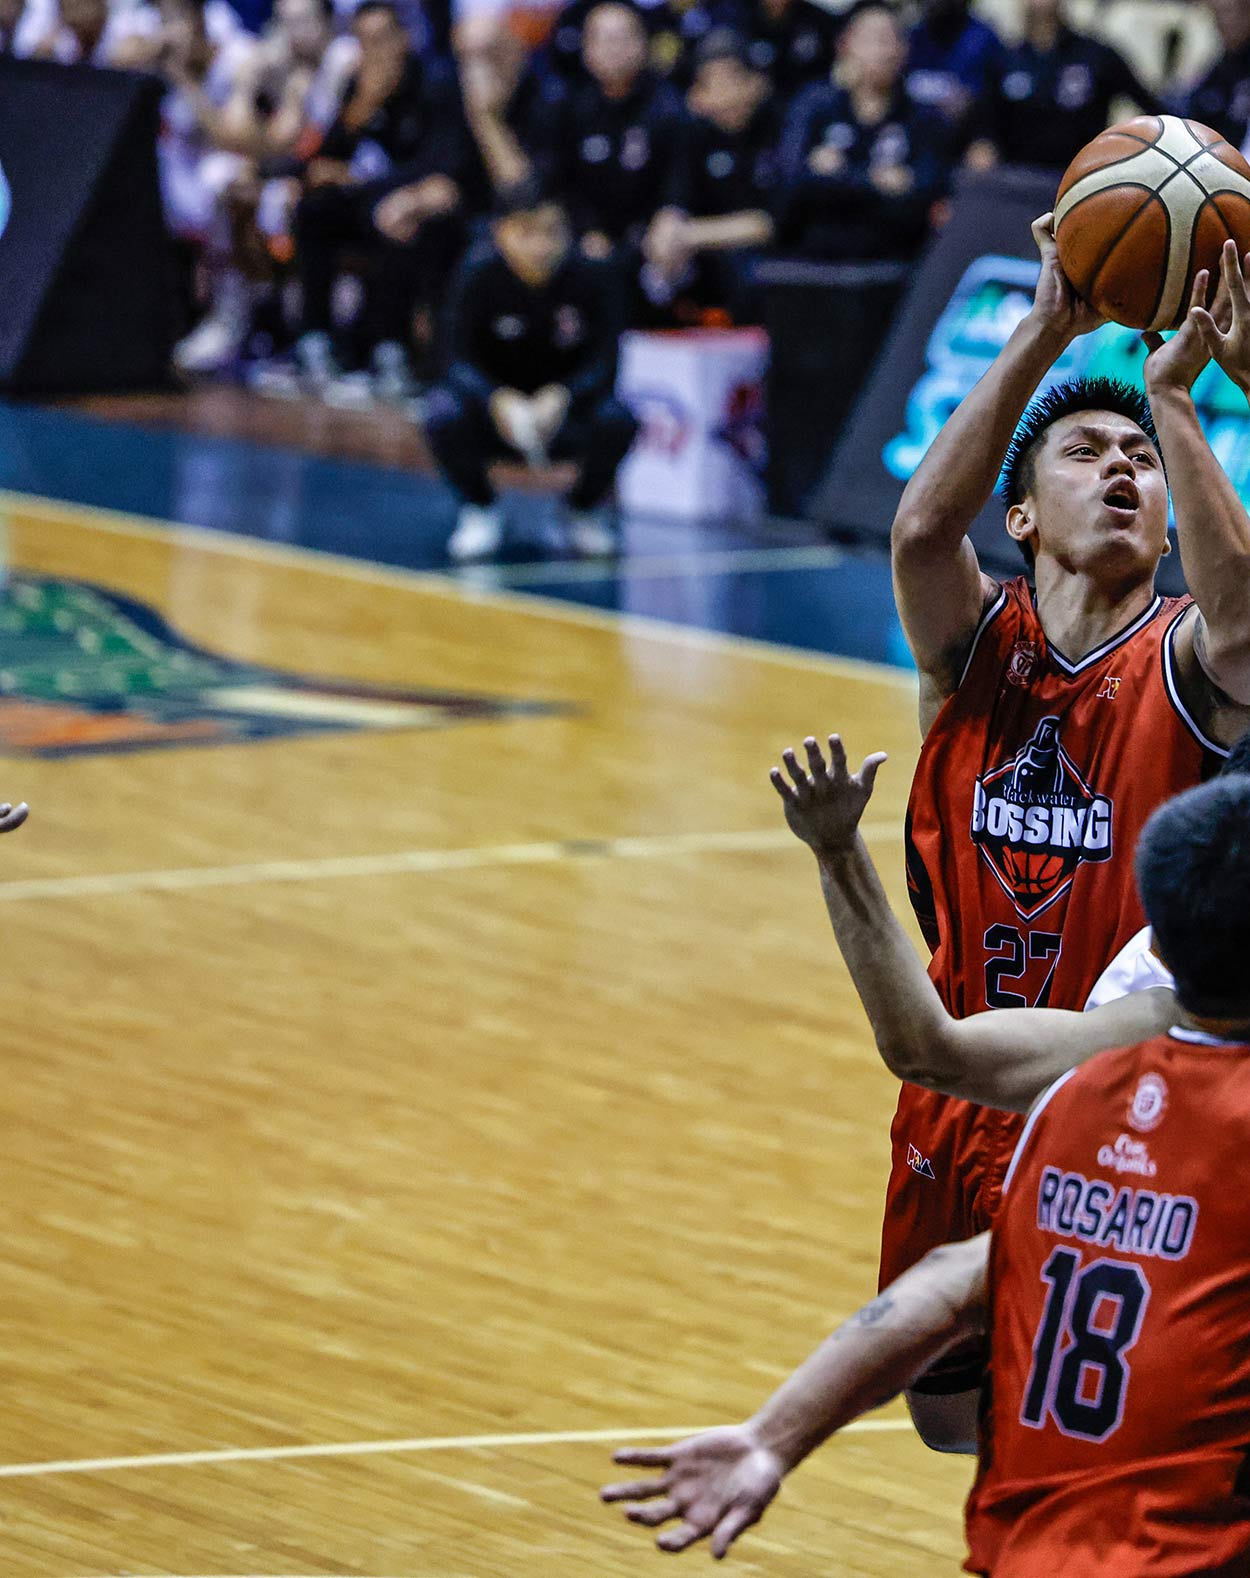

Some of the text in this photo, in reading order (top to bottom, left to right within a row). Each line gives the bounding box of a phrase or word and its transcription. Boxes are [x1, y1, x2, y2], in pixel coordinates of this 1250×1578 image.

[972, 779, 1110, 850] BOSSING
[983, 923, 1063, 1009] 27
[1037, 1165, 1199, 1260] ROSARIO
[1020, 1244, 1152, 1443] 18
